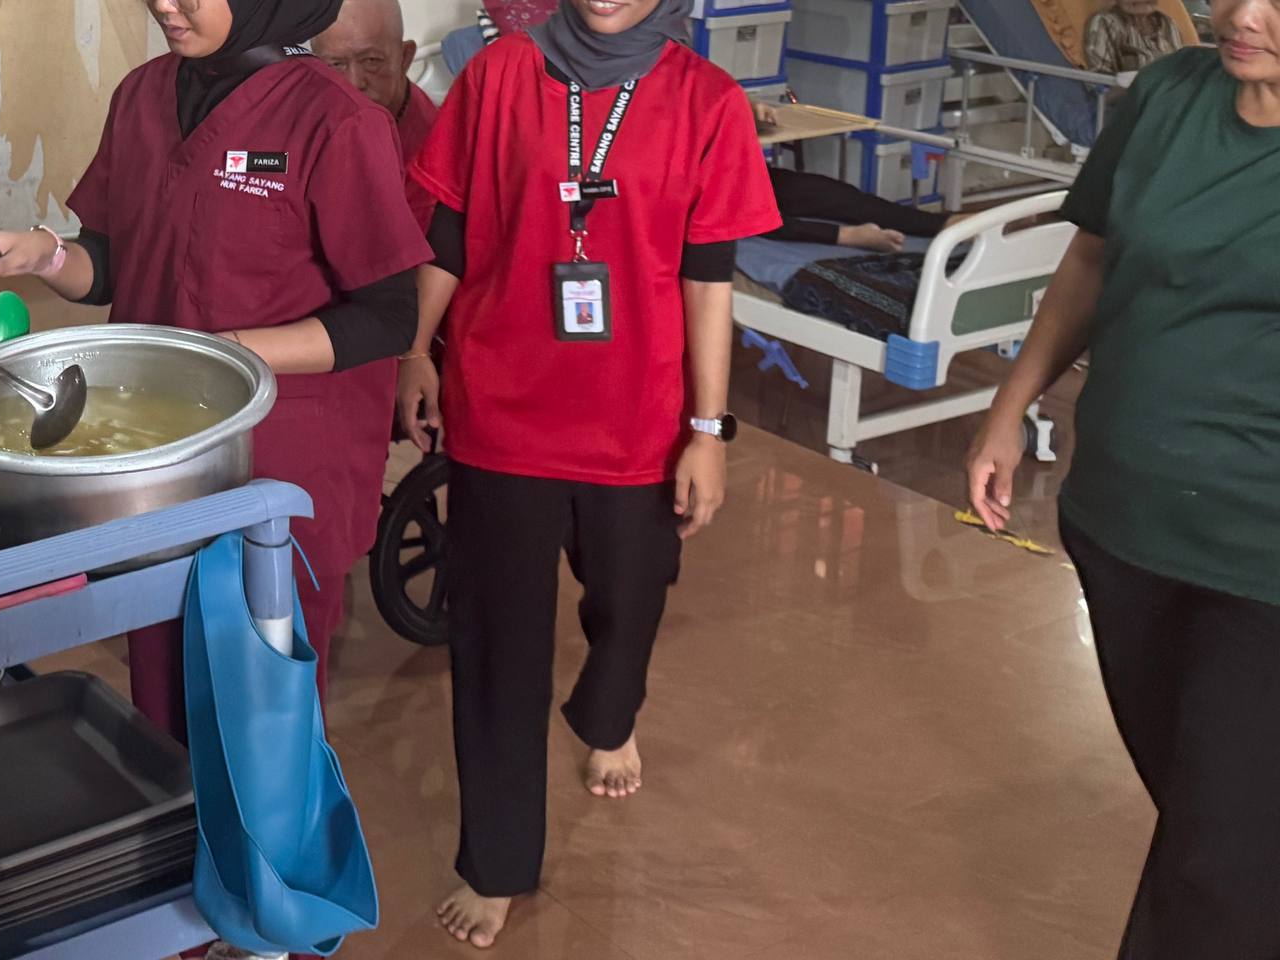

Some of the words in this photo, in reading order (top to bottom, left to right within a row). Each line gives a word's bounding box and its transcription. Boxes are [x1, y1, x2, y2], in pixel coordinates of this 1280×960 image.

[570, 95, 580, 122] CARE
[569, 125, 581, 167] CENTRE
[253, 158, 280, 166] FARIZA
[213, 168, 247, 183] SAYANG
[248, 176, 285, 192] SAYANG
[220, 179, 237, 190] NUR
[238, 184, 269, 198] FARIZA
